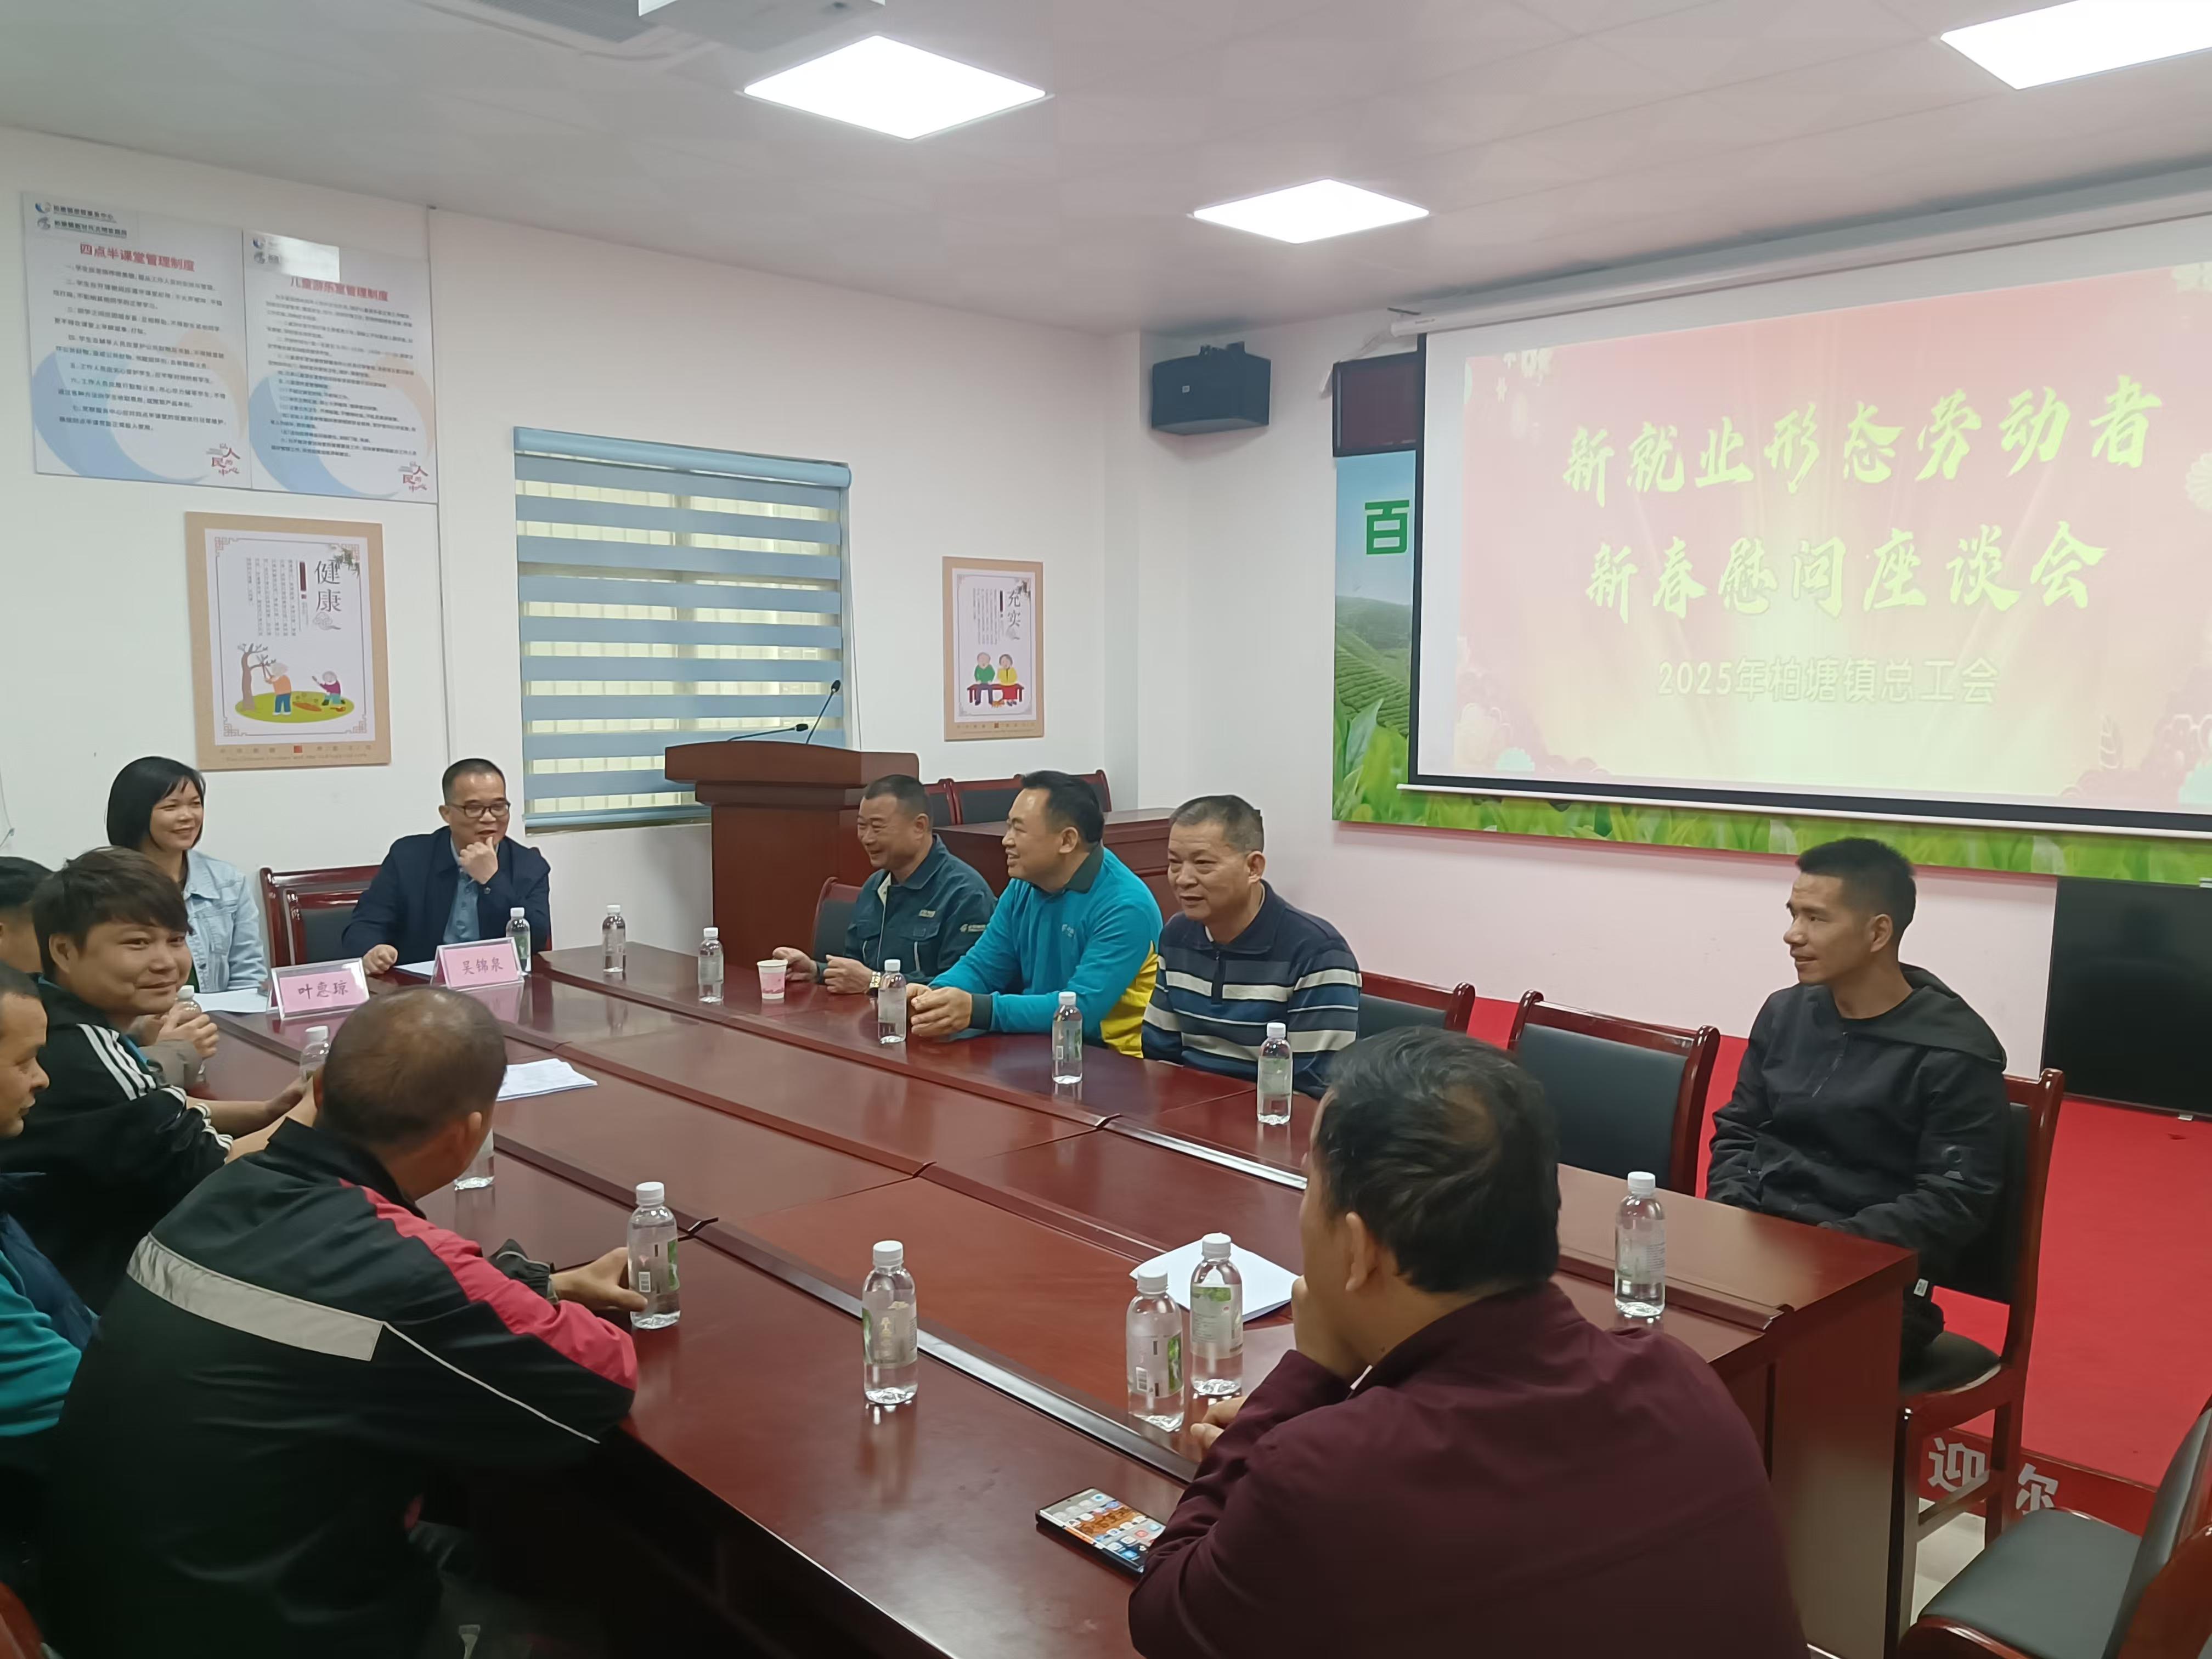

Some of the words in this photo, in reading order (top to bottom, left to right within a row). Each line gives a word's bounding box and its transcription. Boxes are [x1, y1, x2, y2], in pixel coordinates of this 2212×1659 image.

[80, 242, 195, 272] 四点半课堂管理制度
[1562, 375, 2162, 507] 新就业形态劳动者
[1364, 500, 1409, 555] 百
[314, 559, 342, 613] 健康
[1586, 521, 2108, 624] 新春慰问座谈会
[1658, 657, 1999, 704] 2025年柏塘镇总工会
[298, 980, 349, 1000] 叶惠琼
[462, 957, 504, 975] 吴锦泉
